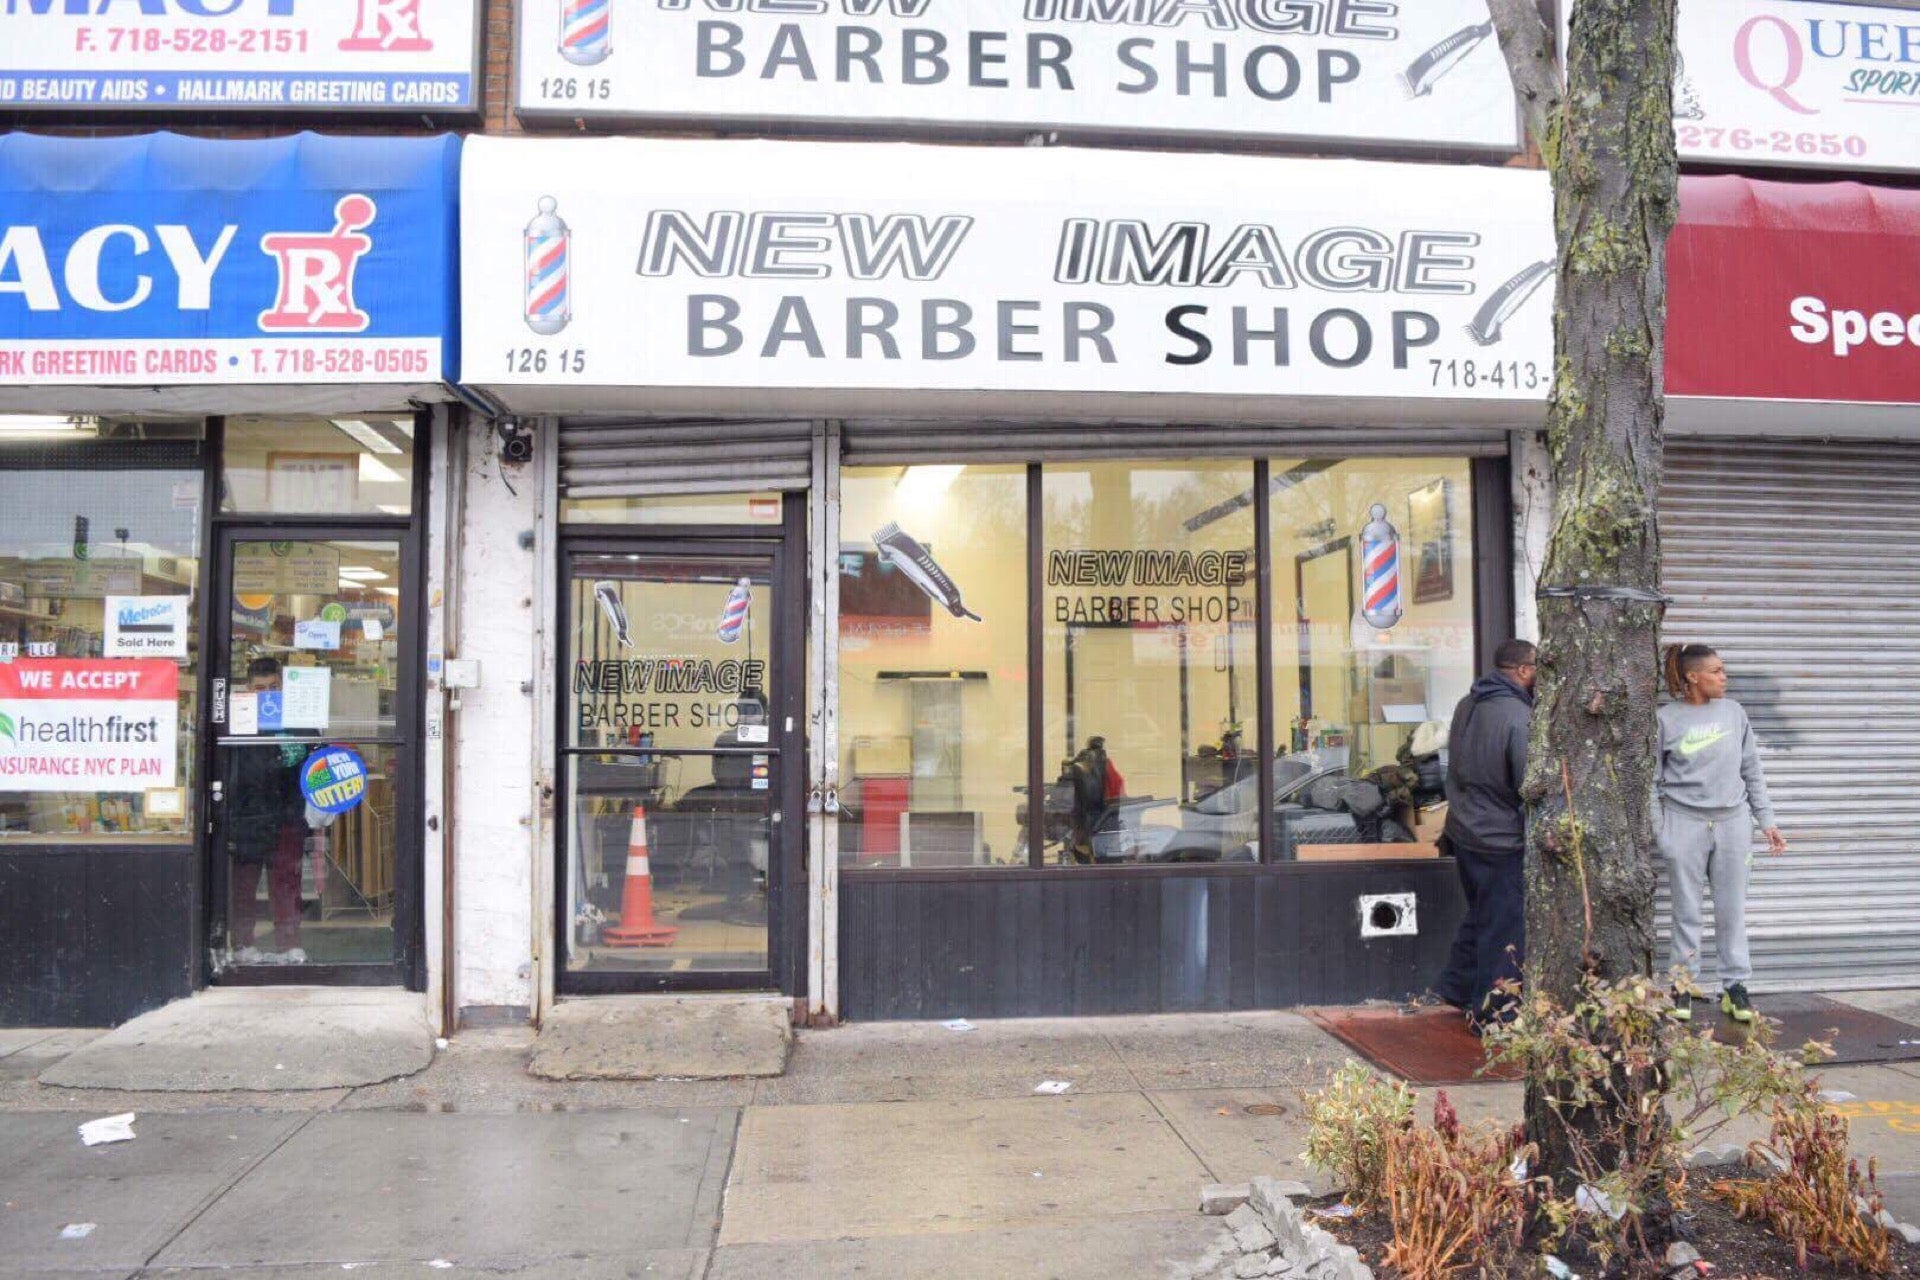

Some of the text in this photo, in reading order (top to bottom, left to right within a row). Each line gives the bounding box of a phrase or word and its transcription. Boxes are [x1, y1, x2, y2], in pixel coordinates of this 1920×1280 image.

[75, 28, 308, 53] F. 718-528-2151
[696, 20, 1362, 103] BARBER SHOP
[23, 79, 97, 100] BEAUTY
[101, 80, 149, 100] AIDS
[177, 80, 285, 101] HALLMARK
[290, 81, 386, 103] GREETING
[392, 82, 460, 103] CARDS
[540, 77, 611, 100] 126 15
[1678, 126, 1867, 158] 276-2650
[635, 209, 1482, 295] NEW IMAGE
[686, 294, 1441, 370] BARBER SHOP
[32, 350, 138, 375] GREETING
[144, 350, 218, 375] CARDS
[251, 349, 268, 374] T.
[276, 349, 428, 374] 718-528-0505
[506, 348, 585, 374] 126 15
[1048, 549, 1248, 588] NEW IMAGE
[1055, 596, 1160, 623] BARBER
[1170, 596, 1241, 623] SHOP
[117, 638, 175, 647] Sold Here
[19, 671, 141, 688] WE ACCEPT
[573, 659, 765, 694] NEW IMAGE
[579, 703, 680, 727] BARBER
[19, 715, 158, 743] healthfirst
[84, 758, 116, 777] NYC
[120, 758, 162, 777] PLAN
